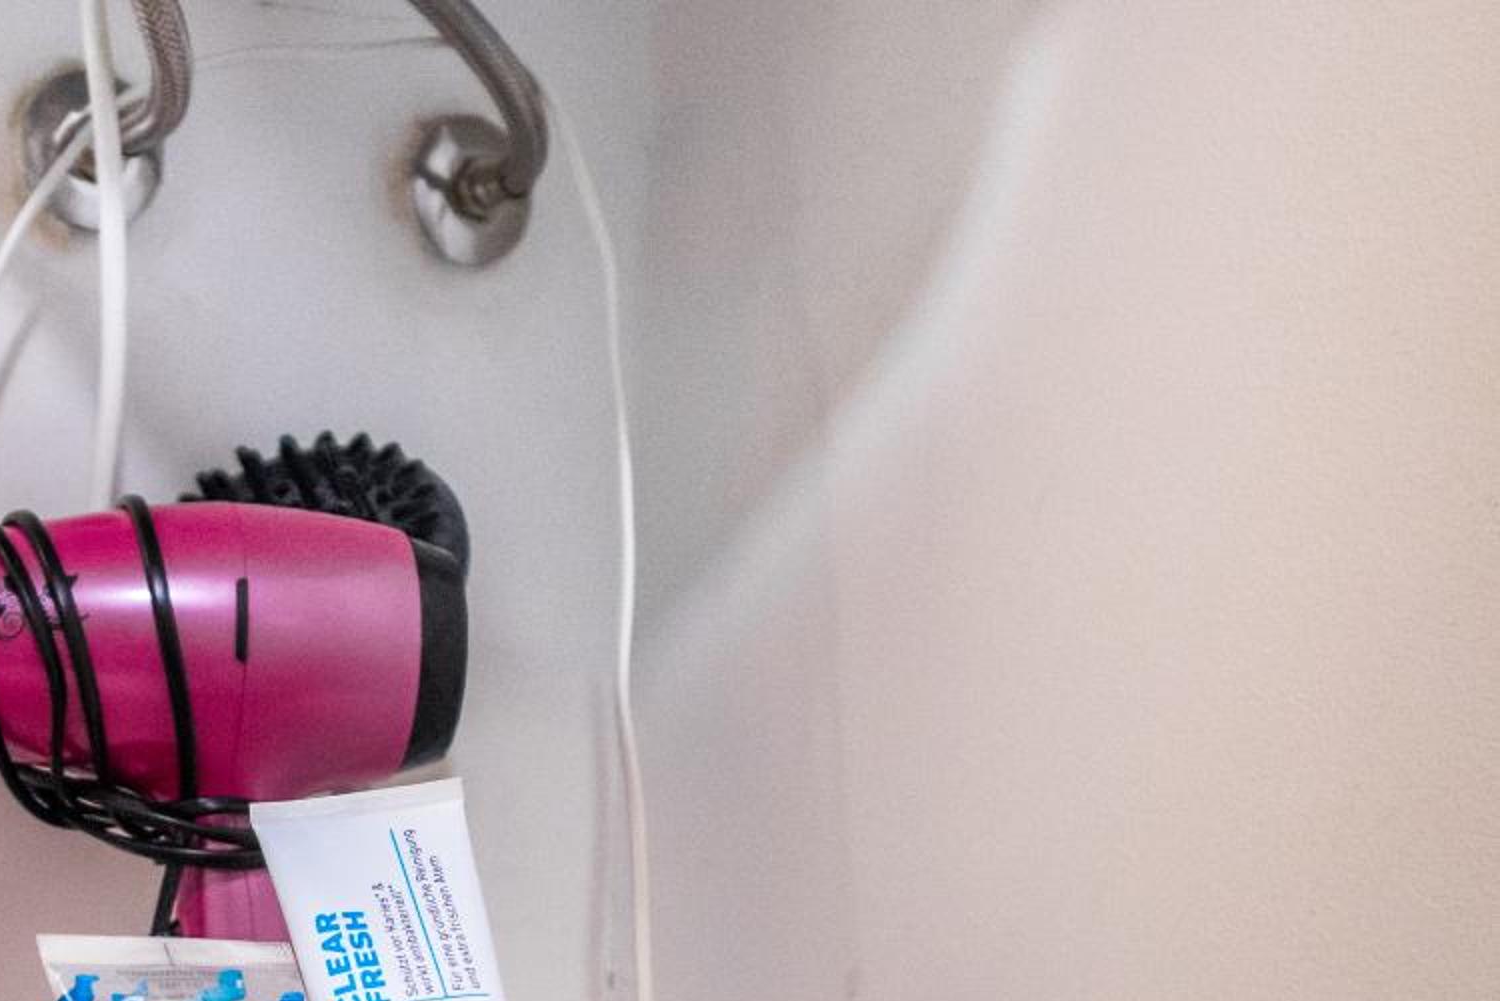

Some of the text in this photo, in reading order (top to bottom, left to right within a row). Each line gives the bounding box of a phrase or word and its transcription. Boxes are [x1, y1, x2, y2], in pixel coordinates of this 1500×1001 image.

[403, 829, 429, 882] Reinigung
[429, 854, 481, 989] und extra frischen Atem
[391, 934, 405, 953] vor
[441, 943, 458, 968] eine
[416, 964, 435, 994] wirkt
